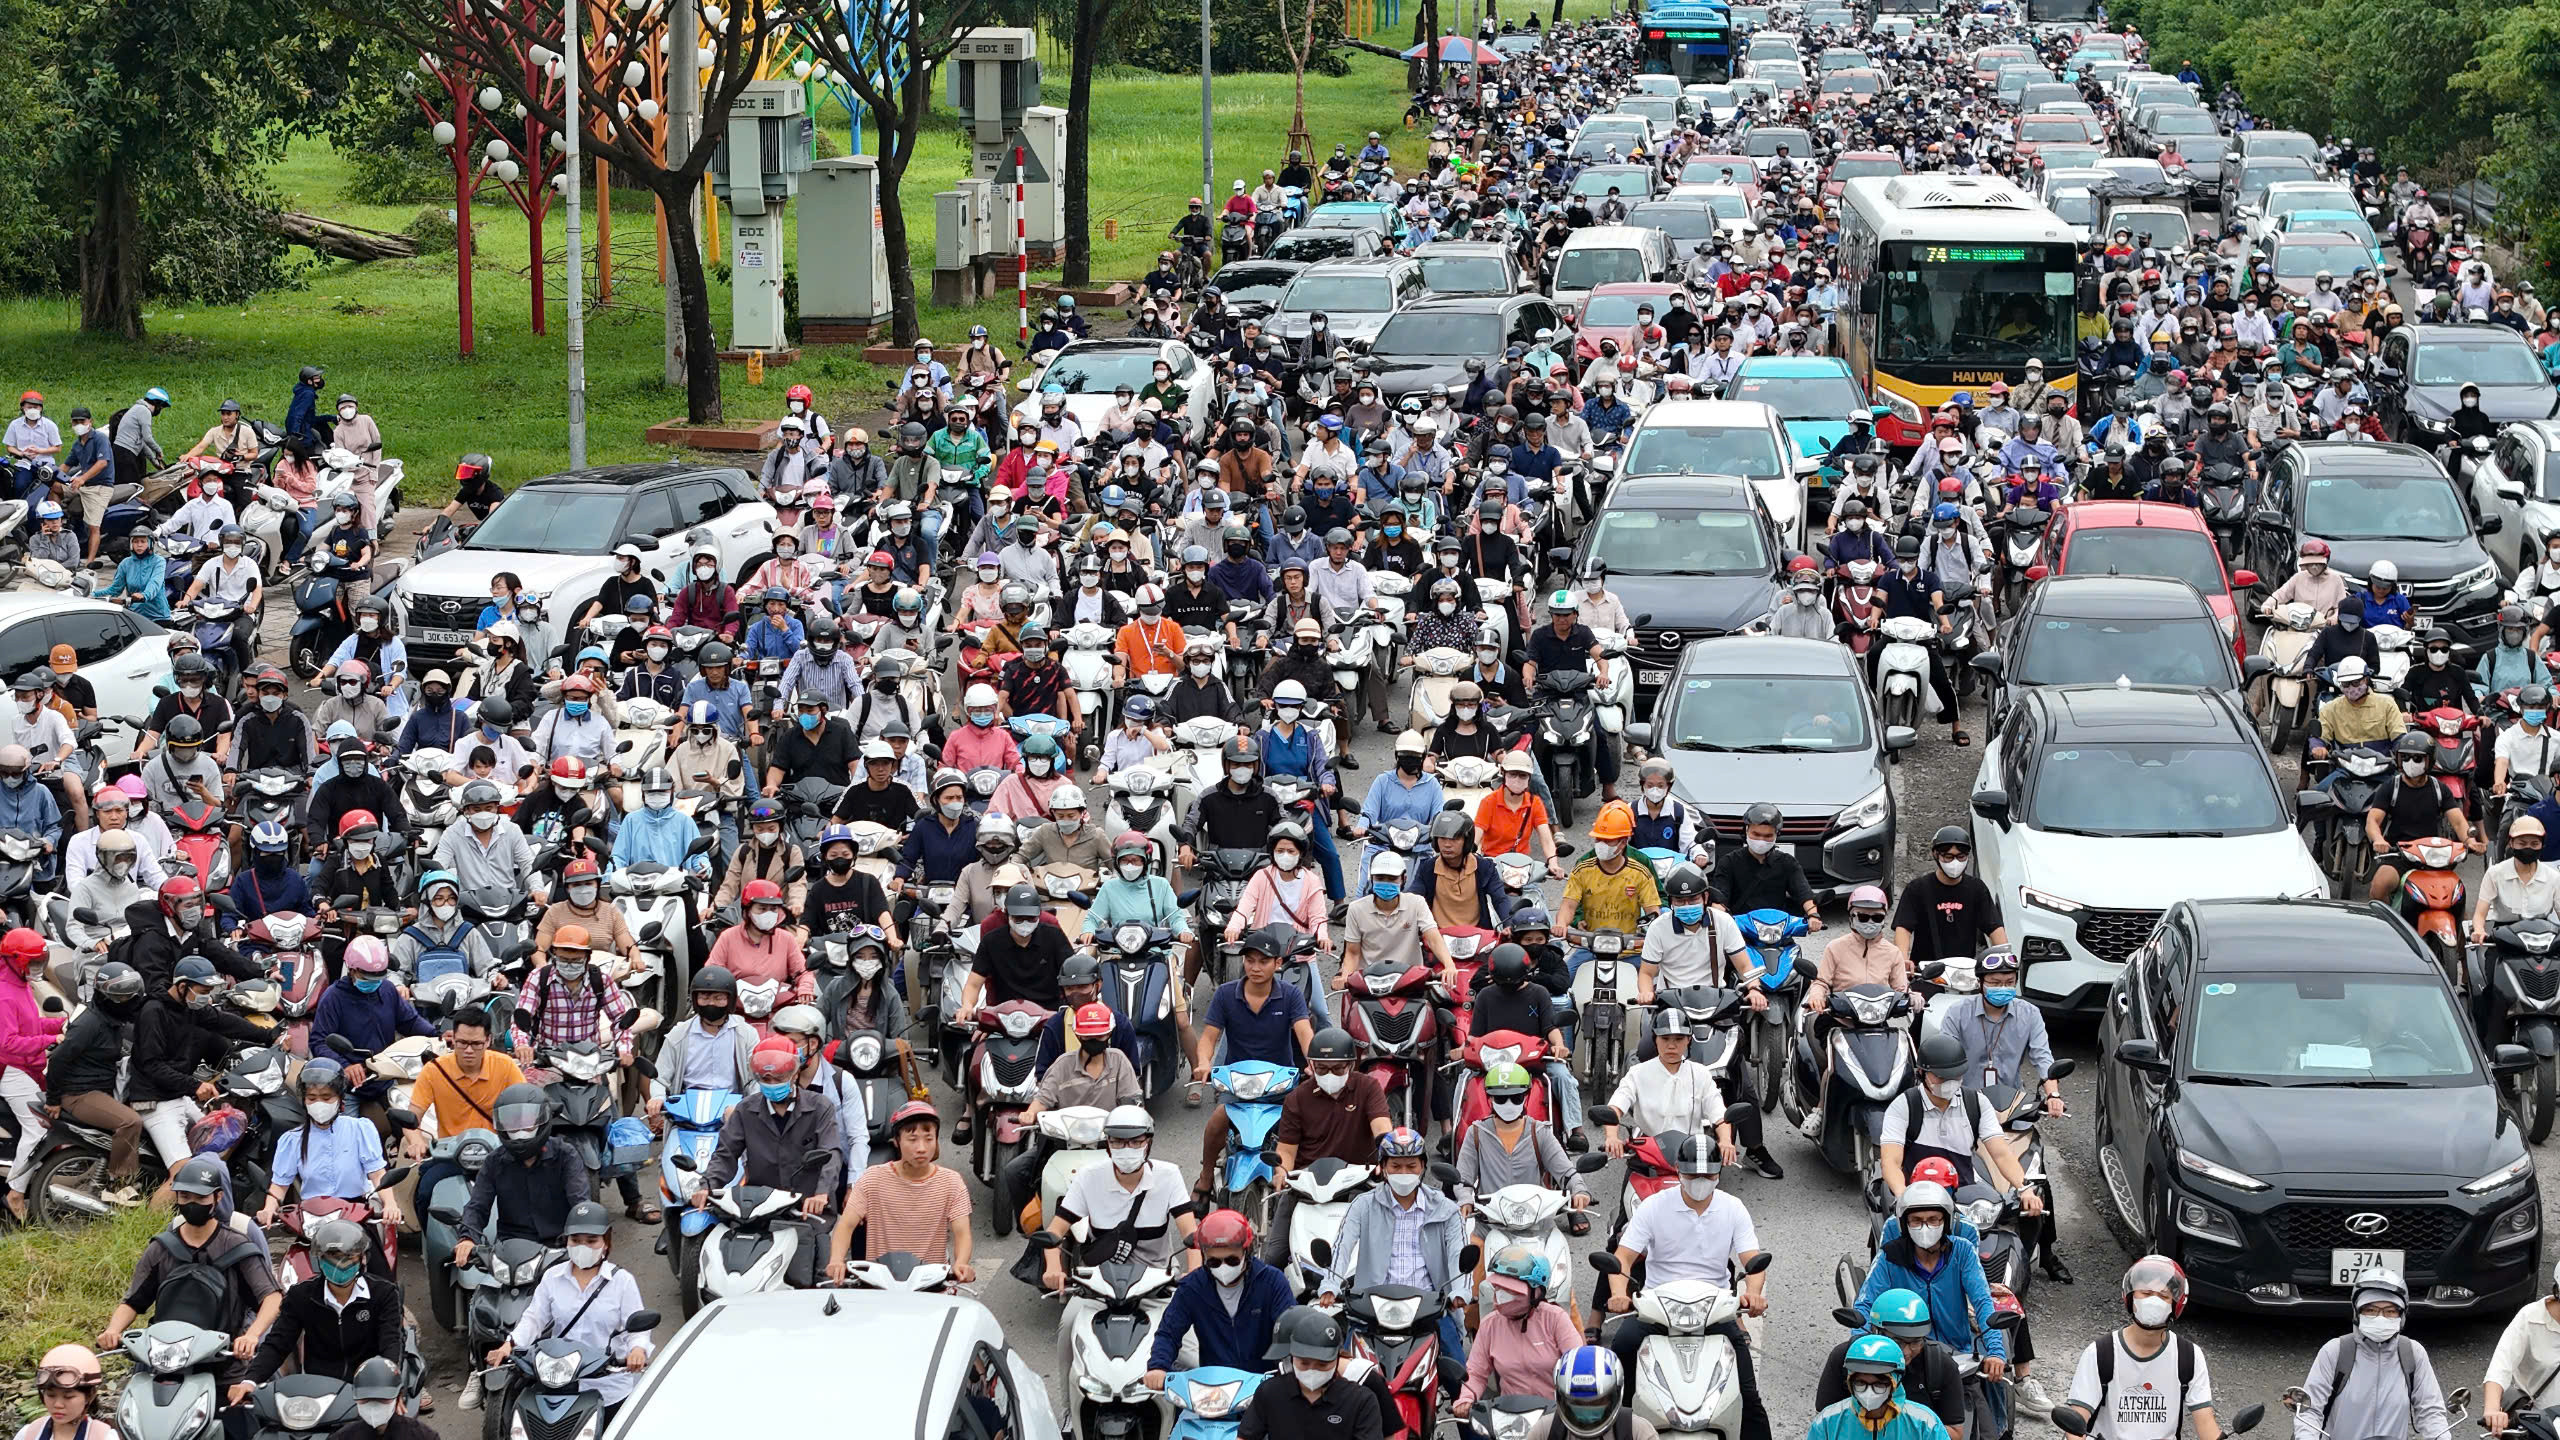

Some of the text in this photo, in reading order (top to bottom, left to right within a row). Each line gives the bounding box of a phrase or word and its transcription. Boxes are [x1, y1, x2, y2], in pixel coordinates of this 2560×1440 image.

[976, 45, 998, 53] EDI
[731, 99, 756, 109] EDI
[980, 152, 1002, 161] EDI
[739, 227, 764, 237] EDI
[1926, 247, 1948, 262] 74
[1952, 371, 2004, 383] HAI VAN
[2353, 1252, 2383, 1267] 37A
[2118, 1395, 2167, 1410] CATSKILL
[2116, 1410, 2167, 1424] MOUNTAINS
